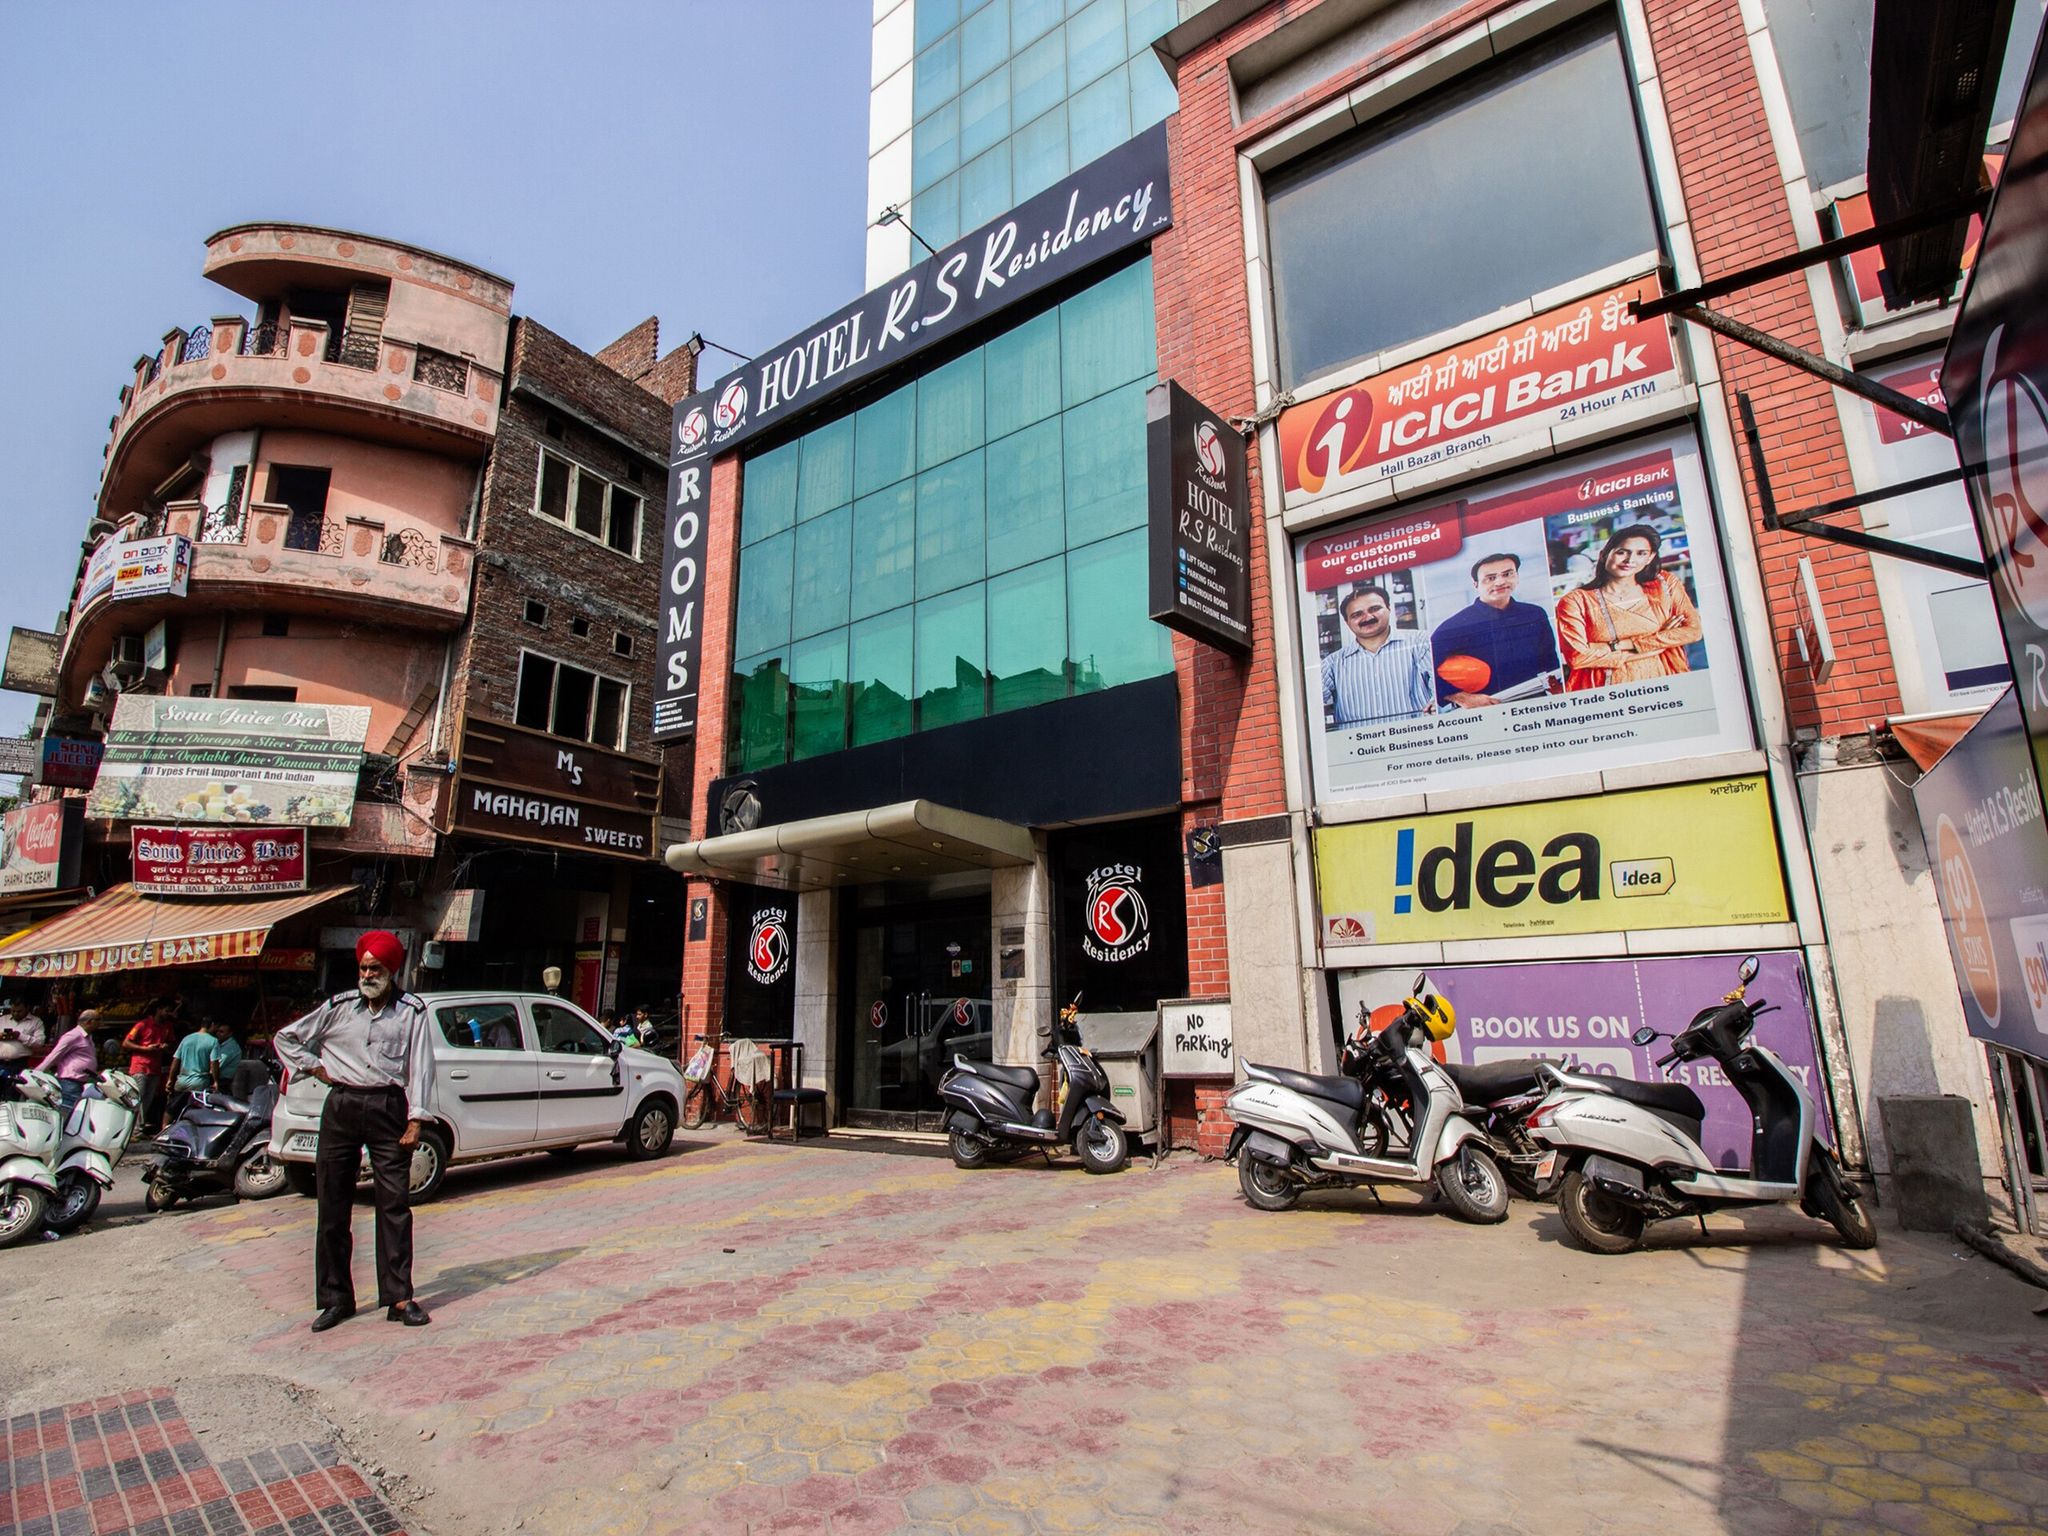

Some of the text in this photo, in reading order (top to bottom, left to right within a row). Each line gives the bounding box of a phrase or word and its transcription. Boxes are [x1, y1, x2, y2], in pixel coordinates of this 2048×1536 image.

[756, 182, 1153, 417] HOTEL R.S Residency
[1378, 340, 1647, 454] ICICI Bank
[1560, 381, 1656, 421] 24 Hour ATM
[1380, 434, 1492, 476] Hall Bazar Branch
[1595, 467, 1670, 496] ICICI Bank
[1187, 480, 1238, 535] HOTEL
[1567, 490, 1674, 524] Business Banking
[1179, 509, 1244, 573] R.S Residency
[1321, 528, 1441, 569] our customised
[1323, 519, 1436, 555] Your business,
[121, 564, 168, 577] DHL FedEx
[174, 538, 190, 583] FedEx
[1197, 558, 1217, 575] FACILITY
[1345, 549, 1417, 575] solutions
[666, 466, 701, 692] ROOMS
[1207, 578, 1226, 595] FACILITY
[1220, 613, 1247, 634] RESTAURANT
[1510, 683, 1670, 717] Extensive Trade Solutions
[160, 704, 326, 729] Sonu Juice Bar
[1355, 713, 1483, 742] Smart Business Account
[1512, 698, 1684, 733] Cash Management Services
[108, 731, 138, 743] Mix
[142, 732, 178, 746] Juice
[182, 733, 251, 748] Pineapple
[255, 736, 286, 748] Slice
[290, 740, 328, 752] Fruit
[1356, 732, 1469, 757] Quick Business Loans
[1387, 730, 1639, 772] For more details, please step into our branch.
[105, 748, 360, 772] Mango Shake Vegetable Juice Banana Shake
[142, 766, 315, 783] All Types Fruit Important And Indian
[473, 789, 644, 849] MAHAJAN SWEETS
[1964, 799, 1994, 848] Hotel
[254, 840, 300, 860] Bar
[185, 885, 208, 893] HALL
[250, 882, 301, 892] AMRITSAR
[1085, 862, 1142, 891] Hotel
[1945, 855, 1972, 933] go
[752, 907, 787, 927] Hotel
[16, 939, 210, 975] SONU JUICE BAR
[1082, 932, 1150, 962] Residency
[747, 957, 789, 984] Residency
[1186, 1013, 1204, 1031] NO
[1470, 1016, 1631, 1039] BOOK US ON
